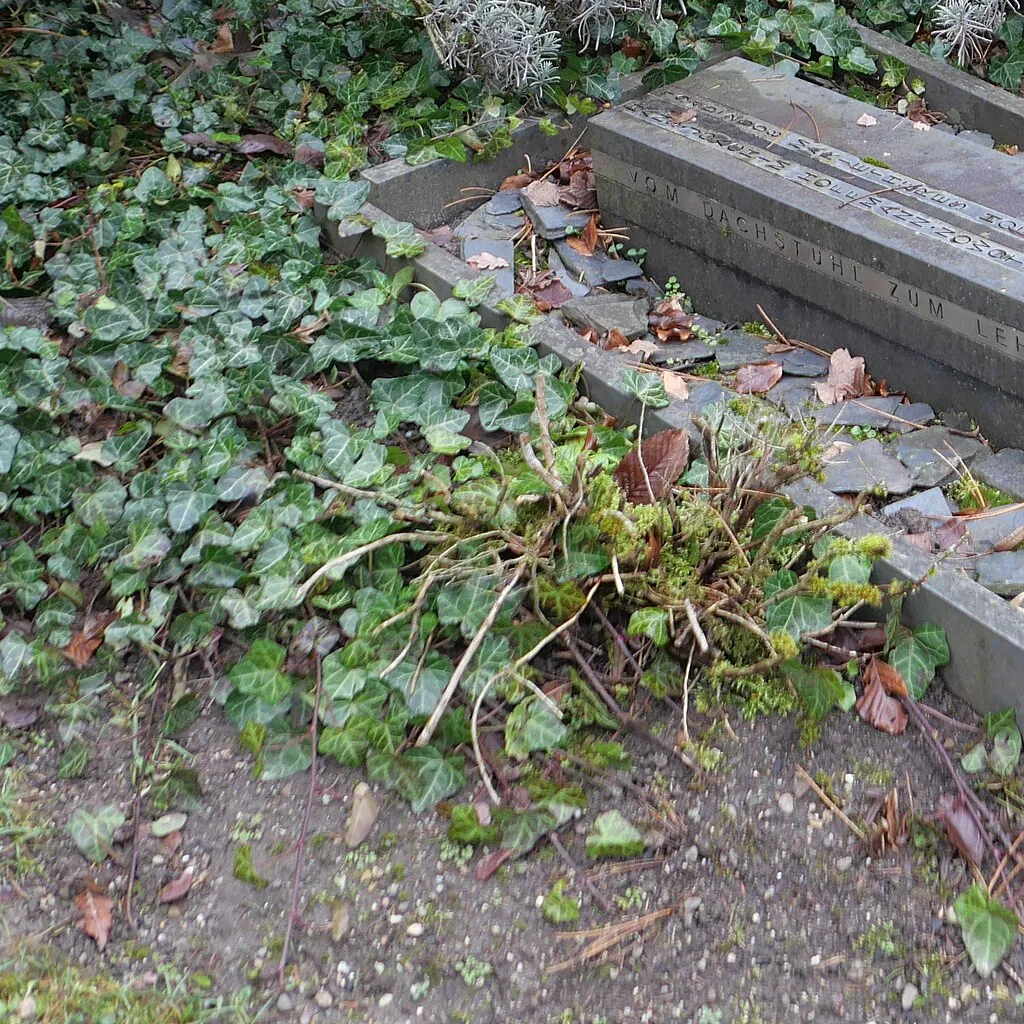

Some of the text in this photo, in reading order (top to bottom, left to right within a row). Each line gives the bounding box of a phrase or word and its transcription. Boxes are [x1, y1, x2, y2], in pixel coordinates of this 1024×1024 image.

[628, 166, 681, 206] VOM
[702, 200, 864, 285] DACHSTUHL
[887, 280, 945, 321] ZUM
